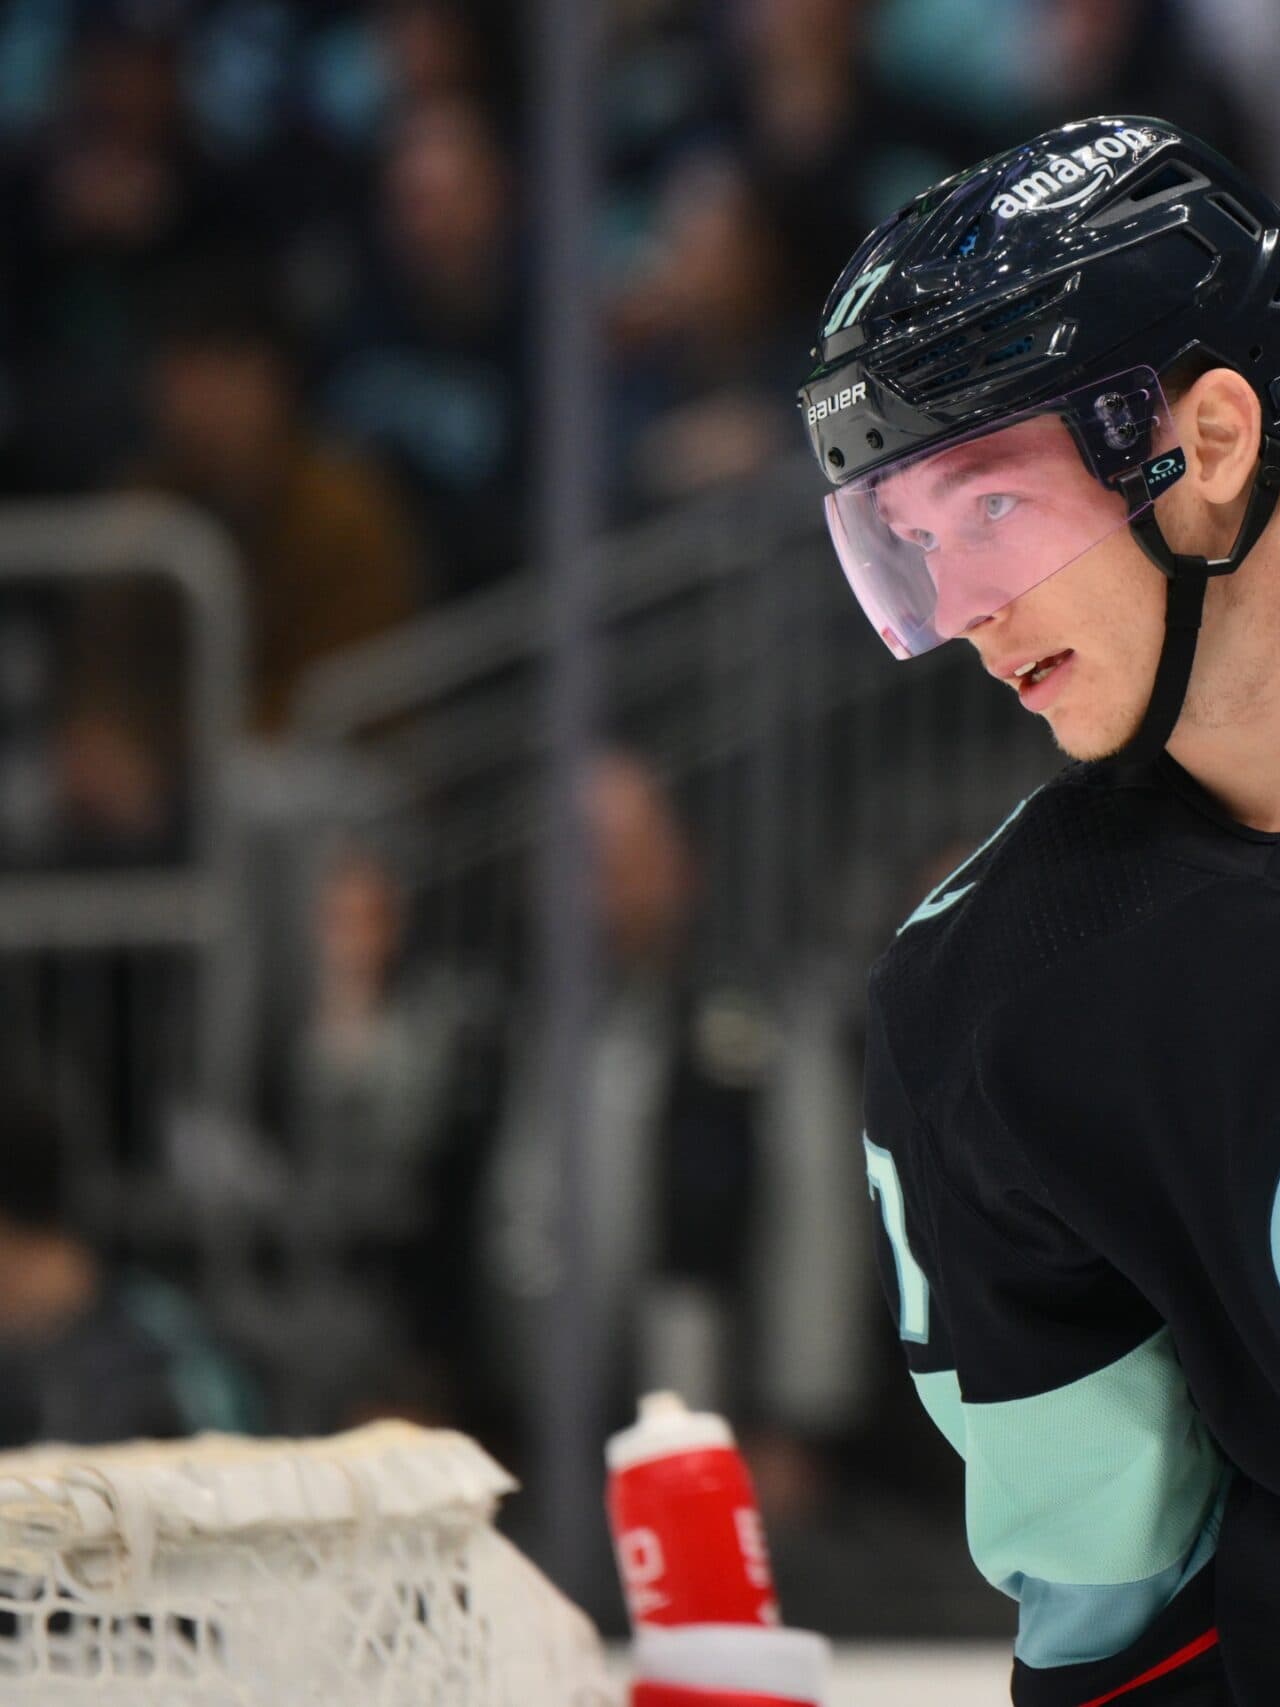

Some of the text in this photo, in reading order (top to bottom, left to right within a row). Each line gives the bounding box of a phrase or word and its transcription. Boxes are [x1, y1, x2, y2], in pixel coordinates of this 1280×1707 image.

[991, 129, 1151, 219] amazon
[808, 381, 866, 426] BAUER
[1148, 463, 1184, 485] OAKLEY
